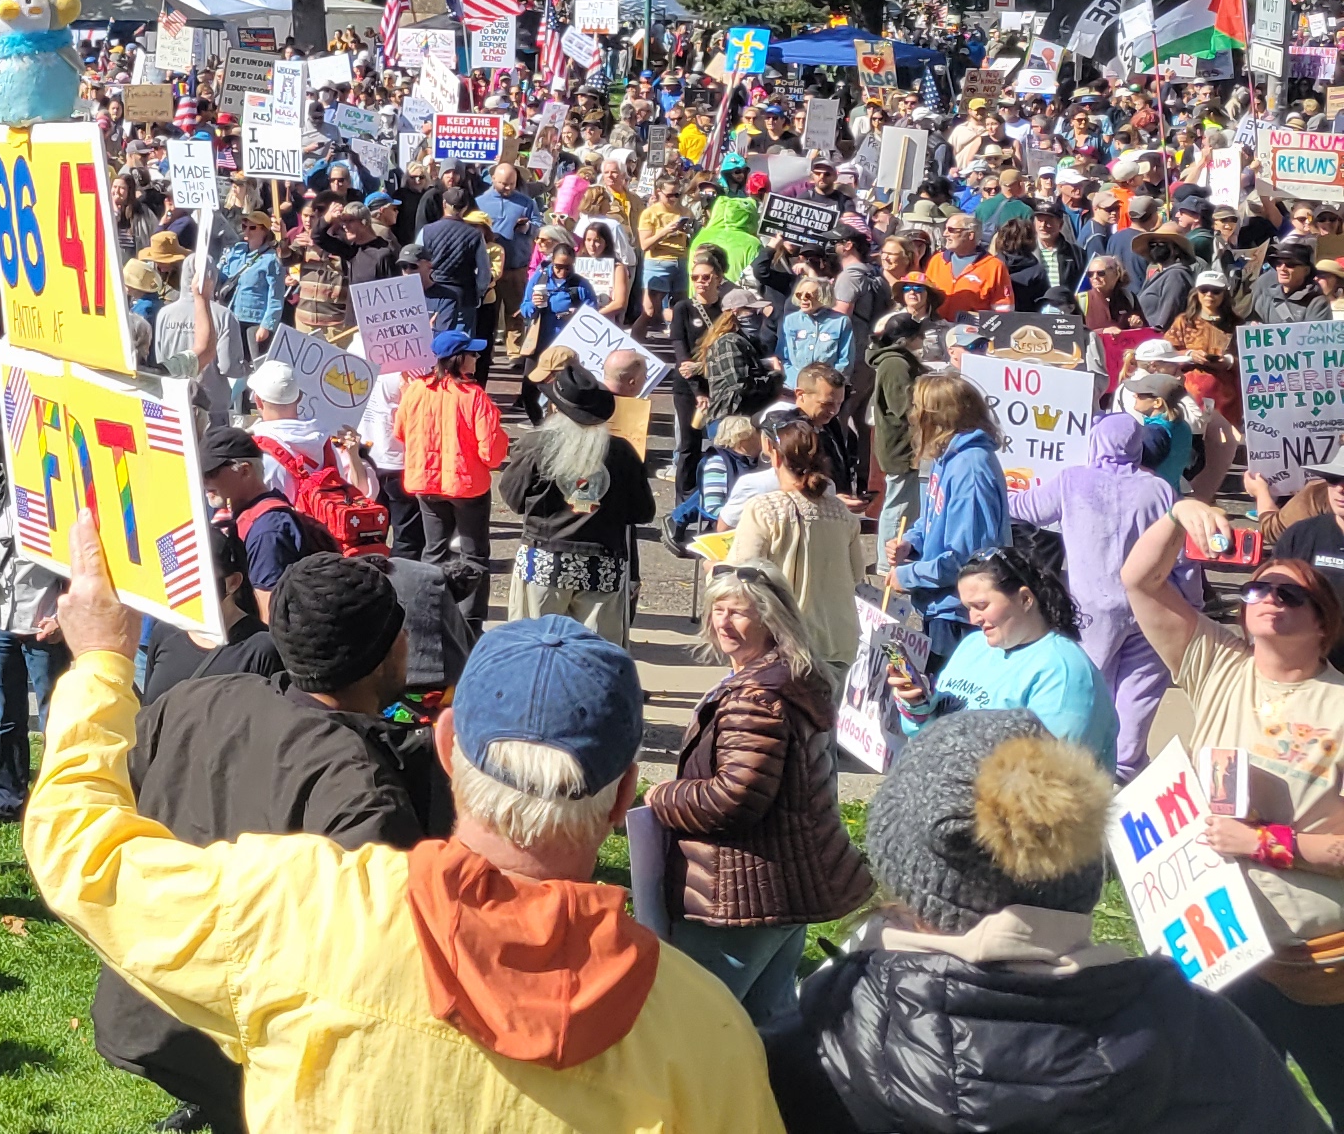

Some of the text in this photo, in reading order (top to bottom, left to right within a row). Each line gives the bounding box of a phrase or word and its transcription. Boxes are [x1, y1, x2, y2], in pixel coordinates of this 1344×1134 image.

[1262, 0, 1278, 13] MUST
[1269, 21, 1281, 33] LEFT
[479, 41, 507, 49] BEFORE
[862, 40, 879, 55] I
[1257, 57, 1275, 70] COLFAX
[862, 71, 896, 86] USA
[438, 126, 498, 136] IMMIGRANTS
[447, 117, 490, 127] KEEP THE
[248, 128, 259, 143] I
[439, 139, 496, 150] DEPORT THE
[1270, 131, 1291, 146] NO
[185, 143, 195, 157] I
[448, 149, 486, 159] RACISTS
[249, 148, 300, 173] DISSENT!
[1278, 155, 1336, 176] RERUNS
[173, 164, 211, 179] MADE
[182, 180, 205, 192] THIS
[771, 198, 832, 224] DEFUND
[770, 210, 829, 232] OLIGARCHS
[58, 162, 106, 317] 47
[784, 231, 799, 242] THE
[356, 285, 407, 309] HATE
[13, 300, 64, 344] ANTIFA AF
[366, 304, 425, 325] NEVER MADE
[376, 323, 418, 341] AMERICA
[1245, 327, 1291, 349] HEY
[276, 331, 324, 376] NO
[369, 342, 428, 365] GREAT.
[1014, 339, 1048, 352] RESIST
[1242, 351, 1315, 374] I DON'T
[1004, 366, 1041, 396] NO
[1247, 390, 1336, 411] BUT I DO
[1247, 420, 1280, 438] PEDOS
[1025, 439, 1066, 462] THE
[1249, 450, 1281, 461] RACISTS
[33, 394, 142, 565] FDT
[890, 625, 929, 659] Worst
[1155, 770, 1200, 838] MY
[1161, 886, 1249, 982] ERA
